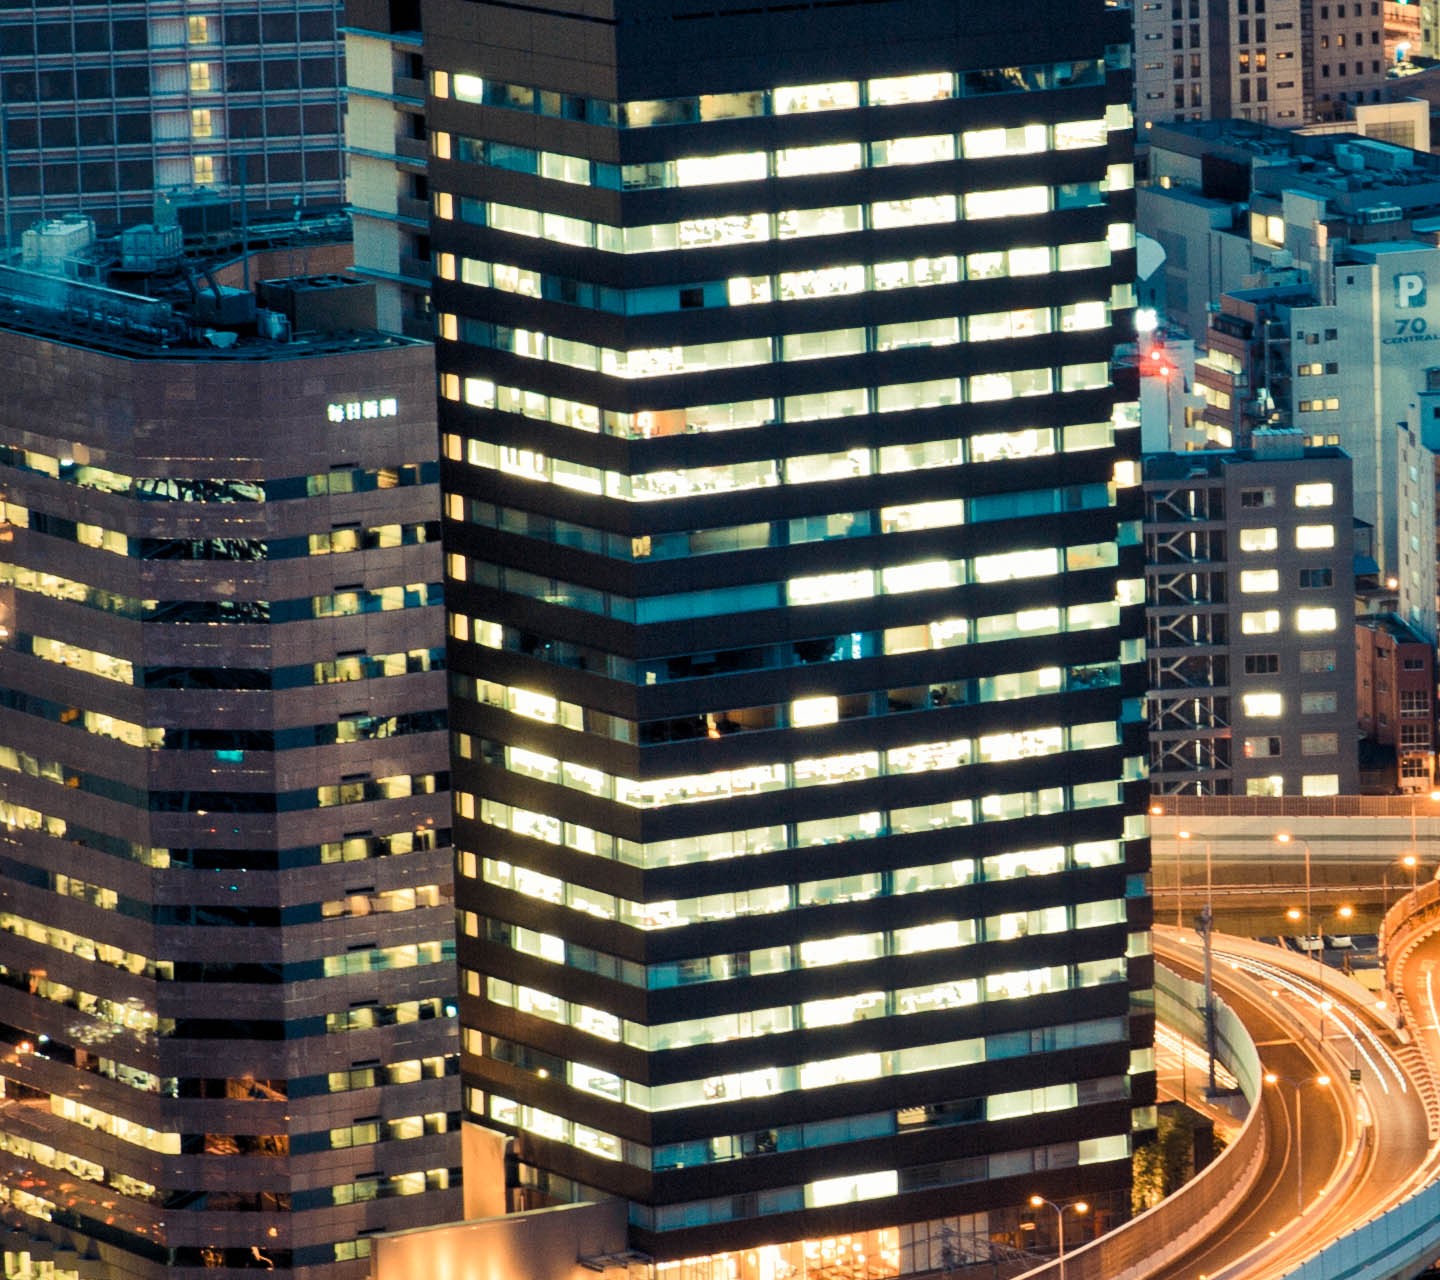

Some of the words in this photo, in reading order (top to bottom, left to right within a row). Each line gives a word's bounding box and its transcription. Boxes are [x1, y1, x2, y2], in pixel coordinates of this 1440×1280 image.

[1399, 274, 1424, 308] P
[1394, 317, 1427, 335] 70
[326, 398, 398, 423] 毎日新聞
